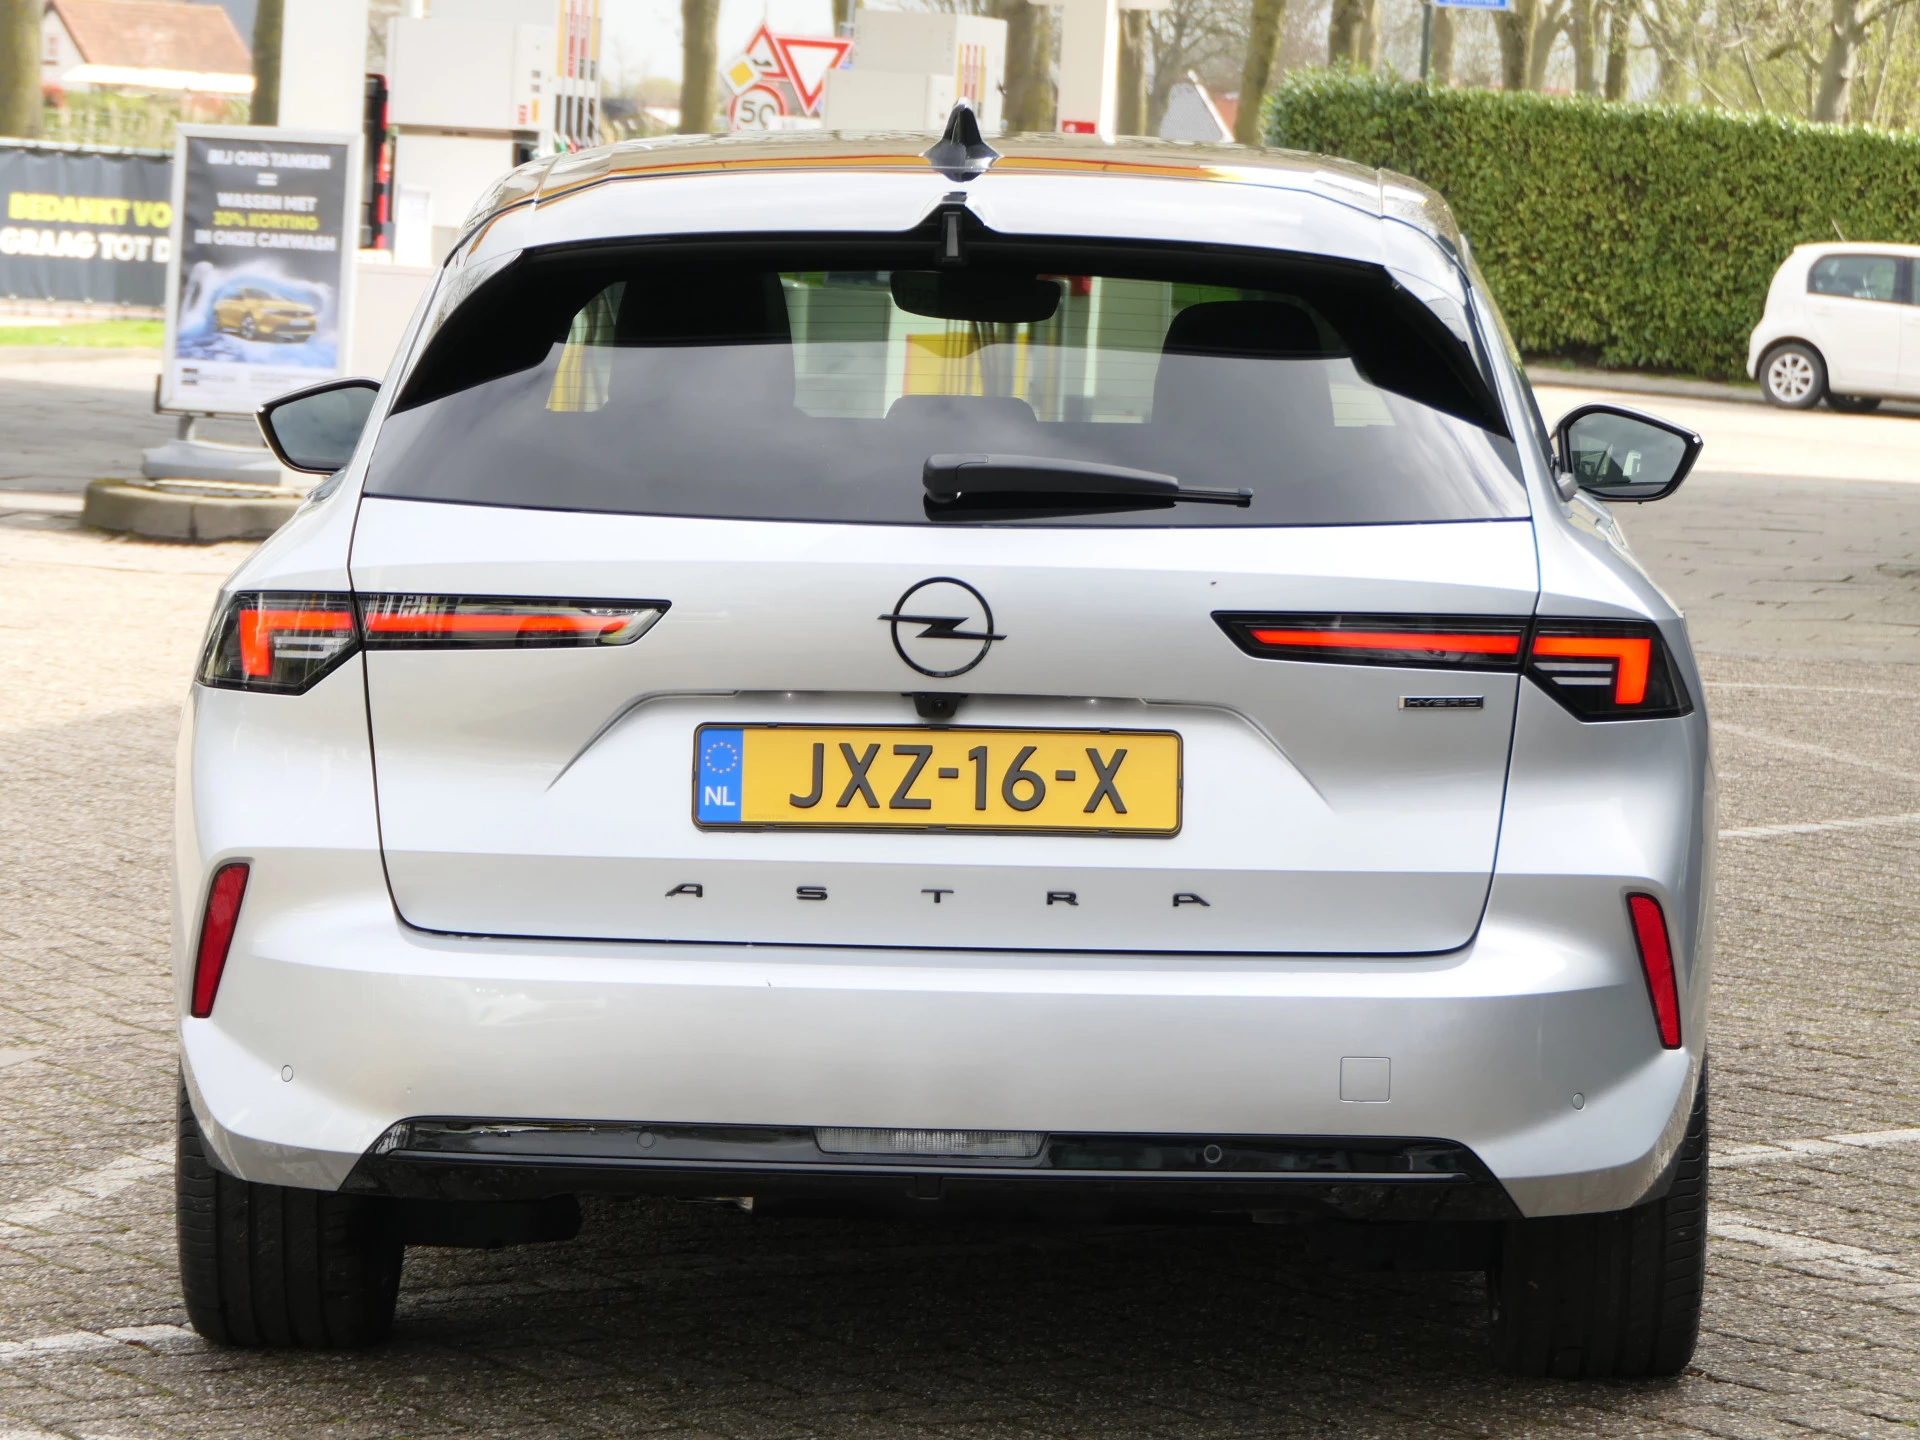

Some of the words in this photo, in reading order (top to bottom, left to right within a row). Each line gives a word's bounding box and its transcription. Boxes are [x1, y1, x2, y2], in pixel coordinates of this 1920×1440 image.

[740, 100, 776, 129] 50
[207, 150, 233, 165] BIJ
[235, 151, 269, 167] ONS
[270, 153, 331, 169] TANKEN
[8, 192, 130, 226] BEDANKT
[216, 192, 282, 210] WASSEN
[284, 195, 318, 212] MET
[248, 213, 319, 231] KORTING
[0, 226, 97, 259] GRAAG
[98, 232, 151, 261] TOT
[194, 229, 212, 244] IN
[213, 230, 256, 247] ONZE
[257, 232, 336, 251] CARWASH
[789, 742, 1128, 814] JXZ-16-X
[704, 785, 736, 806] NL
[665, 882, 1211, 908] ASTRA
